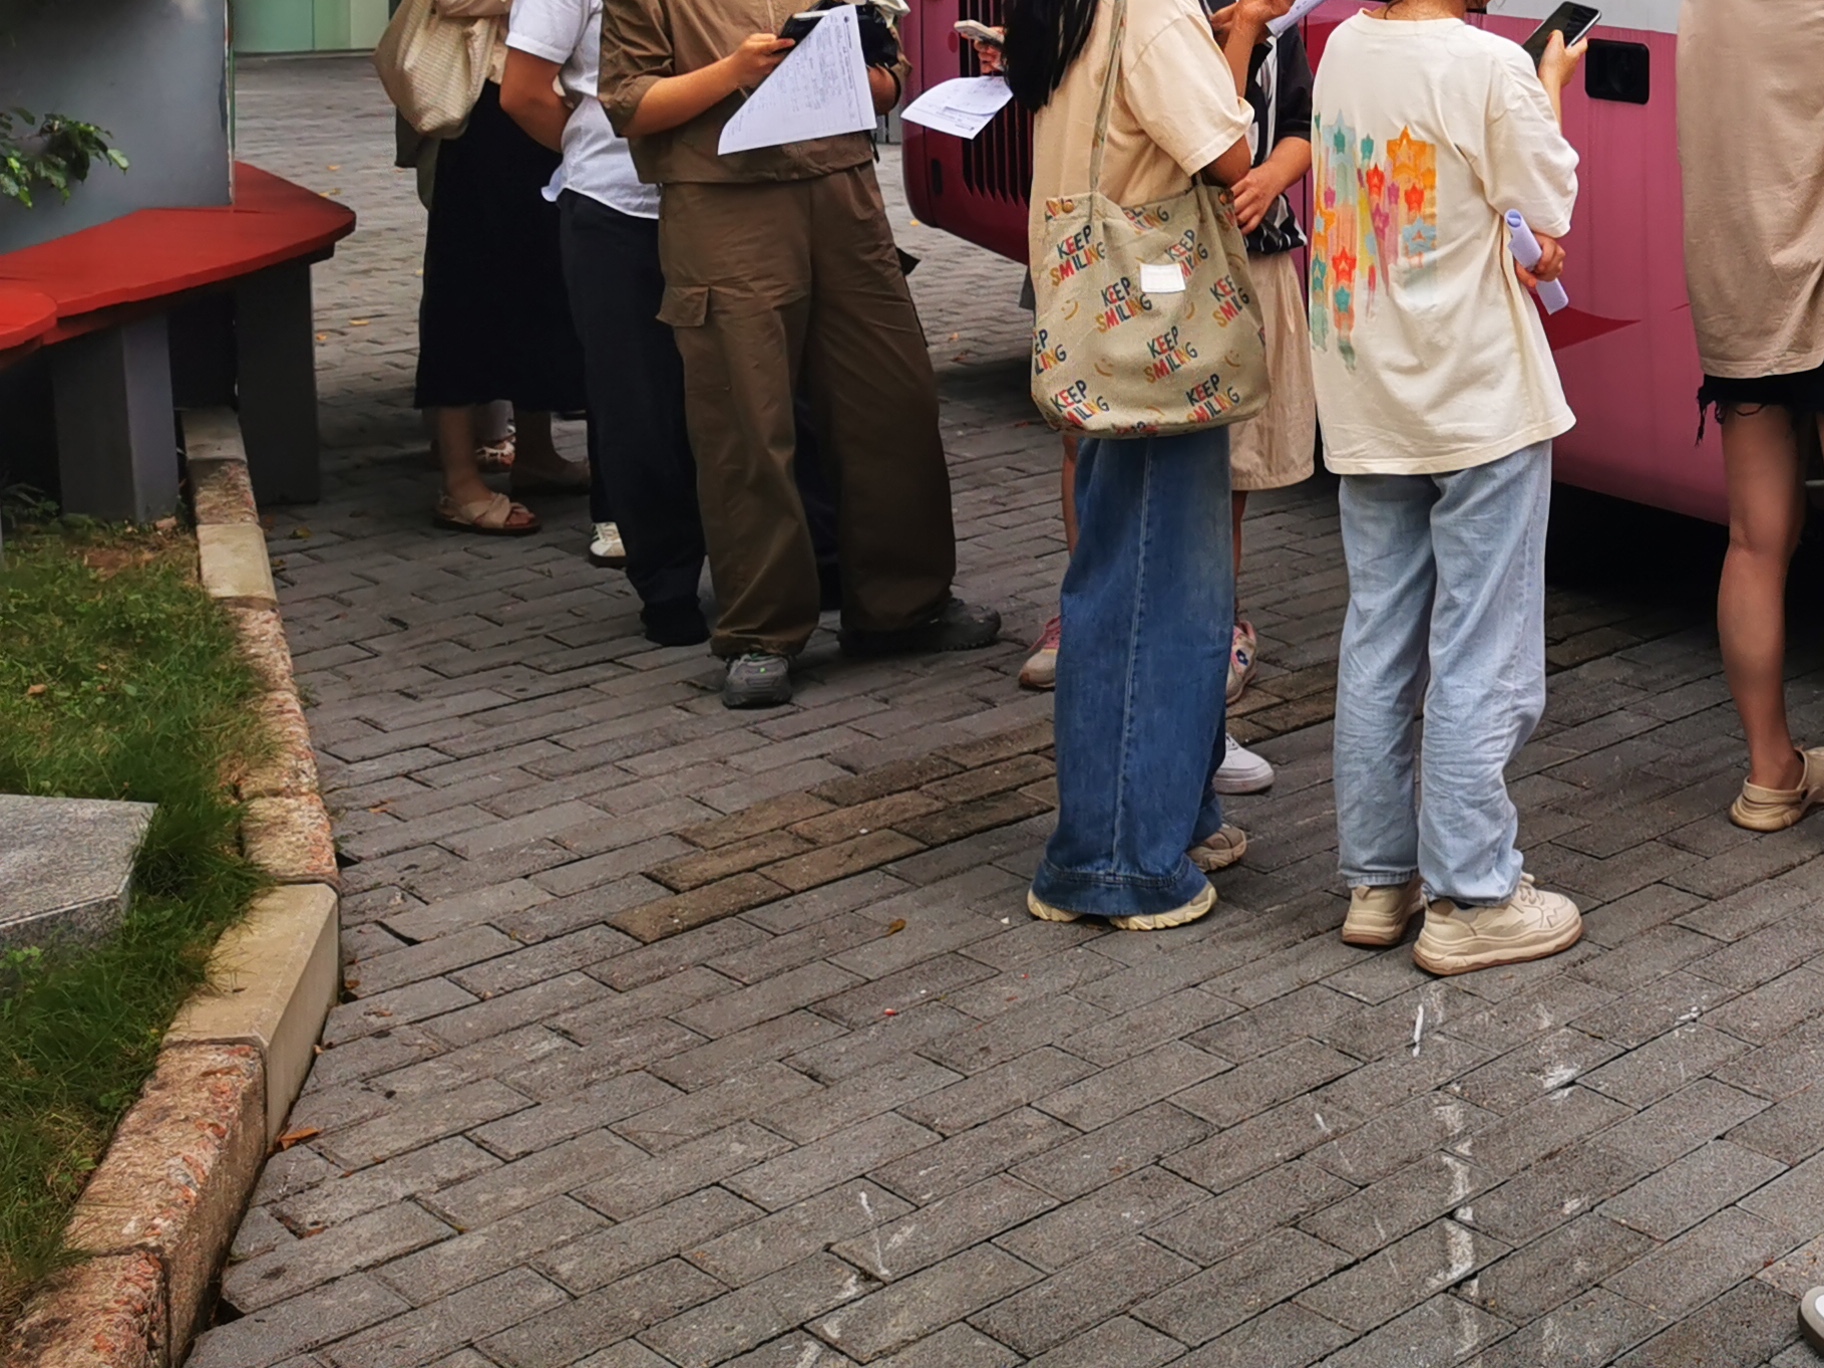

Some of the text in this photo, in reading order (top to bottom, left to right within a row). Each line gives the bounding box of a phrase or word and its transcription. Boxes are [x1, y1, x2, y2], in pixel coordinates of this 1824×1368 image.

[1056, 225, 1092, 259] KEEP
[1049, 241, 1105, 287] SMILING
[1101, 276, 1131, 307] KEEP
[1209, 274, 1235, 302] KEE
[1096, 293, 1152, 334] SMILING
[1147, 325, 1179, 359] KEEP
[1143, 341, 1198, 384] SMILING
[1050, 379, 1087, 413] KEEP
[1186, 373, 1220, 407] KEEP
